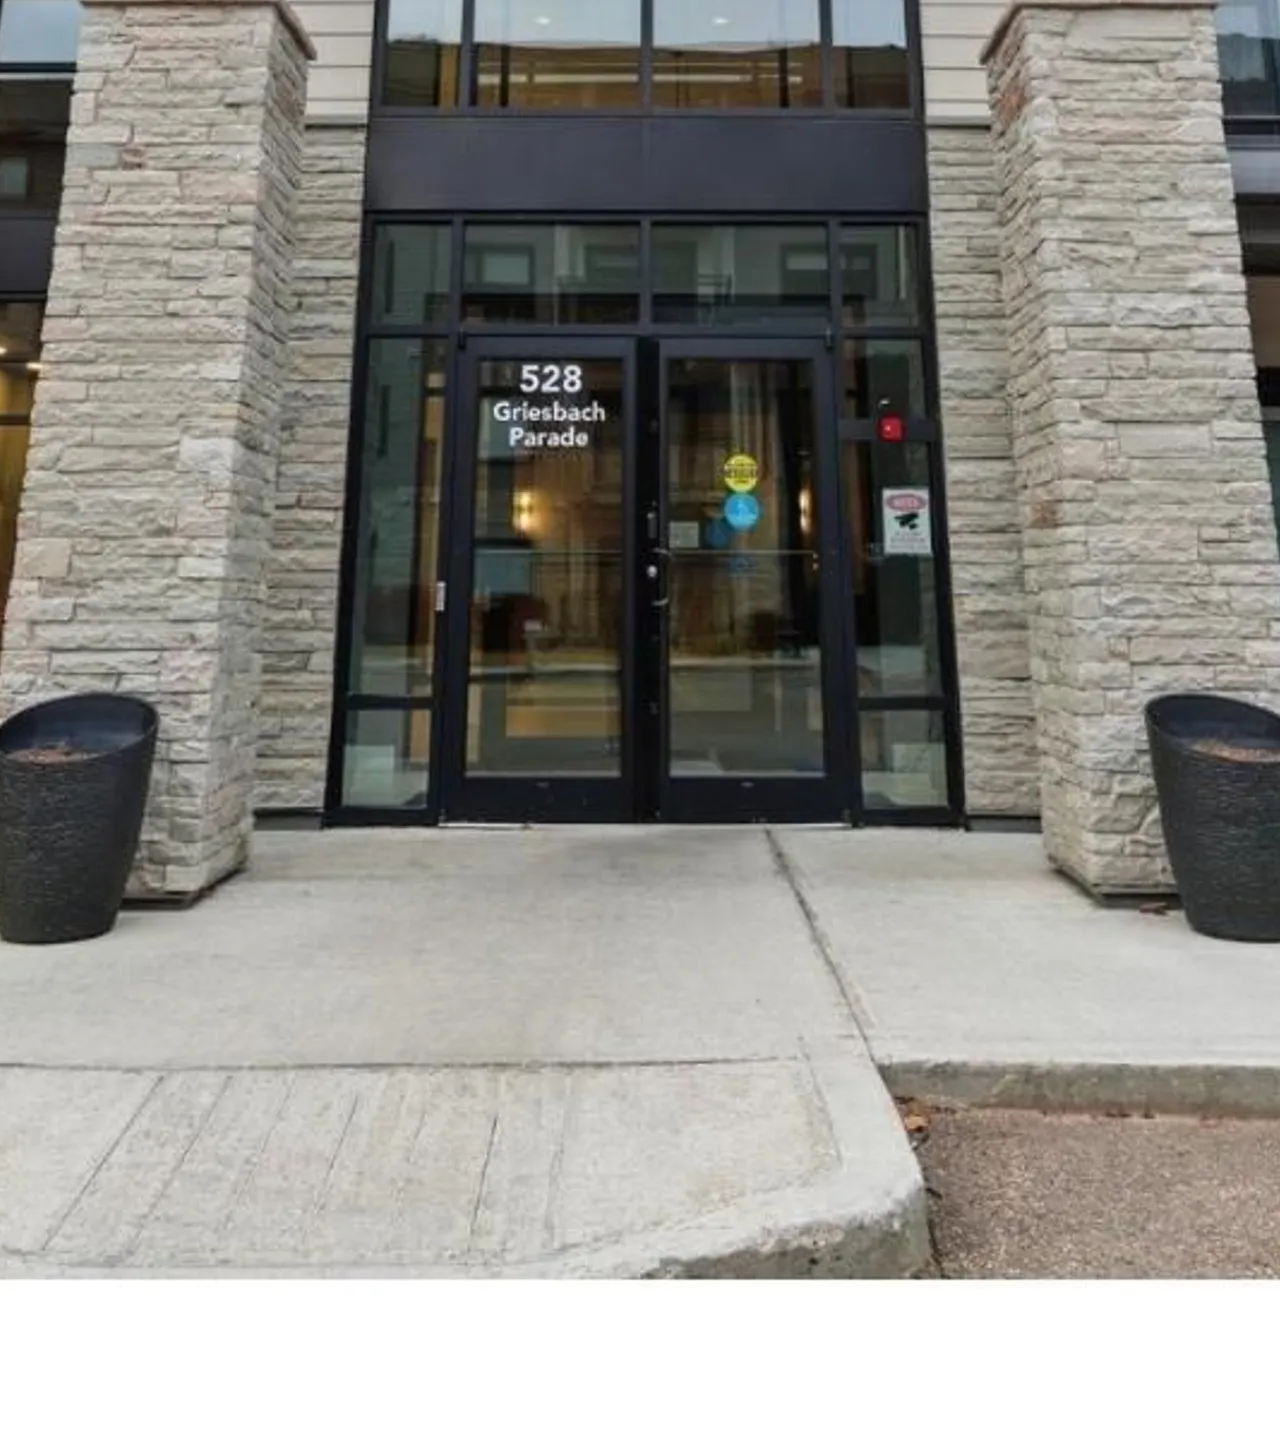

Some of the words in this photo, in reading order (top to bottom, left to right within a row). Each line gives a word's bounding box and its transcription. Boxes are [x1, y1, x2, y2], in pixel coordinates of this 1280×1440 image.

[520, 364, 582, 393] 528
[493, 400, 606, 422] Griesbach
[509, 426, 589, 447] Parade
